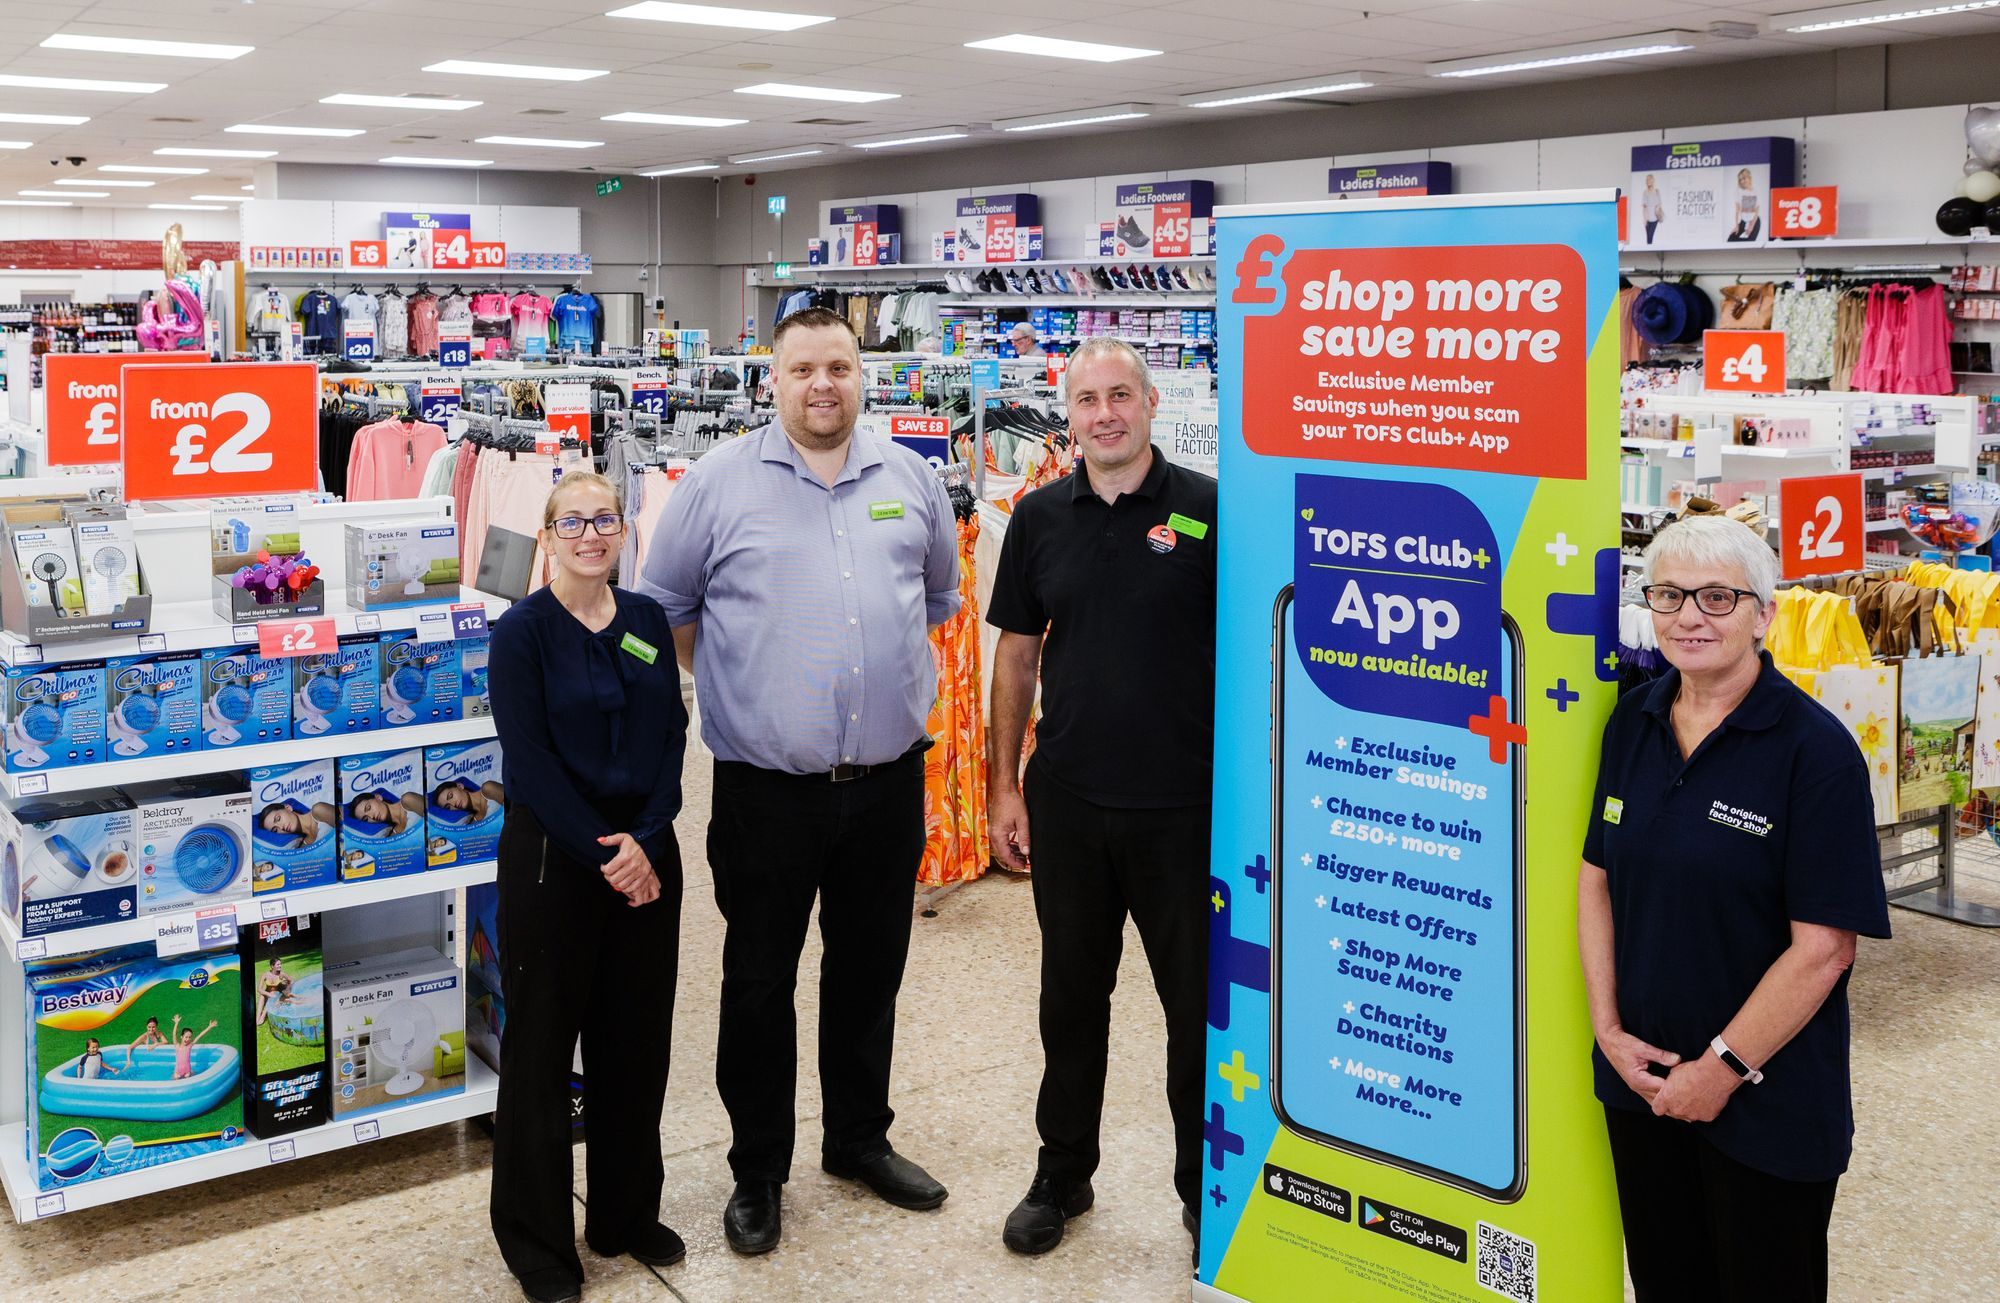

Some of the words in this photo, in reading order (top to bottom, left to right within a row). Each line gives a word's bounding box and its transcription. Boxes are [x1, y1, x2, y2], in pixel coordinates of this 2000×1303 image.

[1666, 154, 1721, 169] fashion
[1341, 178, 1373, 190] Ladies
[1376, 175, 1418, 188] Fashion
[1121, 194, 1146, 204] Ladies
[1148, 192, 1185, 203] Footwear
[1677, 190, 1714, 203] FASHION
[1779, 200, 1799, 208] from
[962, 206, 980, 215] Men's
[982, 205, 1012, 214] Footwear
[1677, 203, 1716, 216] FACTORY
[1784, 197, 1821, 229] £8
[419, 219, 440, 228] Kids
[1155, 218, 1189, 243] £45
[856, 232, 874, 258] £6
[987, 227, 1014, 250] £55
[358, 245, 379, 263] £6
[434, 235, 469, 265] £4
[475, 247, 503, 263] £10
[1300, 269, 1414, 322] shop
[1426, 277, 1562, 313] more
[349, 344, 371, 356] £20
[1300, 323, 1414, 358] save
[1426, 326, 1561, 363] more
[444, 351, 466, 362] £18
[1721, 344, 1767, 383] £4
[637, 371, 662, 379] Bench.
[1318, 371, 1406, 392] Exclusive
[1410, 374, 1495, 395] Member
[68, 381, 117, 400] from
[1165, 387, 1194, 398] FASHION
[150, 398, 208, 419] from
[424, 404, 459, 422] £25
[637, 398, 664, 413] 12
[1292, 395, 1366, 417] Savings
[1370, 398, 1428, 418] when
[1431, 404, 1470, 424] you
[1474, 406, 1520, 424] scan
[169, 392, 273, 475] £2
[897, 420, 927, 432] SAVE
[929, 421, 943, 432] £8
[1302, 423, 1347, 442] your
[1353, 424, 1402, 443] TOFS
[1407, 426, 1466, 446] Club+
[1469, 430, 1510, 454] App
[395, 530, 408, 538] Fan
[423, 529, 452, 538] STATUS
[1799, 496, 1844, 561] £2
[1308, 526, 1388, 560] TOFS
[1394, 534, 1491, 570] Club+
[458, 616, 483, 631] £12
[1331, 579, 1461, 651] App
[282, 624, 317, 652] £2
[341, 664, 355, 673] GO
[355, 659, 372, 669] FAN
[425, 655, 438, 664] GO
[439, 651, 455, 660] FAN
[251, 672, 266, 682] GO
[266, 668, 284, 678] FAN
[1309, 645, 1358, 669] now
[1361, 653, 1488, 689] available!
[114, 664, 193, 692] Chillmax
[159, 682, 173, 690] GO
[174, 676, 193, 687] FAN
[15, 673, 97, 702] Chillmax
[61, 692, 77, 701] GO
[78, 686, 97, 697] FAN
[1350, 736, 1456, 771] Exclusive
[435, 754, 494, 781] Chillmax
[474, 764, 492, 775] PILLOW
[1306, 750, 1393, 780] Member
[1395, 766, 1488, 801] Savings
[351, 764, 413, 792] Chillmax
[392, 774, 412, 786] PILLOW
[260, 773, 324, 803] Chillmax
[303, 784, 322, 797] PILLOW
[143, 807, 185, 818] Beldray
[144, 819, 170, 827] ARCTIC
[172, 816, 193, 824] DOME
[1326, 797, 1407, 827] Chance
[1411, 812, 1435, 832] to
[1439, 819, 1482, 844] win
[1712, 800, 1729, 812] the
[1730, 806, 1768, 825] original
[103, 824, 132, 832] convenient
[105, 820, 125, 828] portable
[1709, 808, 1743, 828] factory
[1743, 820, 1768, 836] shop
[1330, 819, 1398, 846] £250+
[1401, 835, 1461, 861] more
[1316, 853, 1388, 884] Bigger
[1391, 871, 1493, 910] Rewards
[51, 898, 82, 908] SUPPORT
[26, 910, 47, 918] FROM
[27, 915, 52, 924] Beldray
[54, 910, 83, 918] EXPERTS
[1330, 896, 1400, 927] Latest
[1404, 913, 1477, 946] Offers
[158, 923, 194, 937] Beldray
[203, 923, 232, 940] £35
[262, 920, 287, 937] MY
[1344, 938, 1400, 969] Shop
[1404, 953, 1462, 983] More
[414, 980, 454, 993] STATUS
[1337, 958, 1392, 987] Save
[1395, 973, 1454, 1002] More
[43, 985, 127, 1013] Bestway
[352, 992, 375, 1004] Desk
[377, 988, 394, 999] Fan
[1360, 1003, 1448, 1043] Charity
[1337, 1017, 1455, 1064] Donations
[265, 1080, 286, 1090] 6ft
[286, 1072, 319, 1086] safari
[1344, 1058, 1400, 1089] More
[1404, 1076, 1462, 1107] More
[266, 1086, 297, 1101] quick
[299, 1081, 317, 1091] set
[279, 1092, 305, 1107] pool
[1355, 1083, 1432, 1120] More...
[1288, 1176, 1319, 1193] Download
[1320, 1186, 1329, 1196] on
[1329, 1189, 1342, 1201] the
[1288, 1185, 1312, 1207] App
[1314, 1195, 1345, 1214] Store
[1389, 1210, 1404, 1221] GET
[1405, 1214, 1411, 1223] IT
[1412, 1216, 1423, 1227] ON
[1389, 1220, 1434, 1246] Google
[1435, 1234, 1460, 1257] Play
